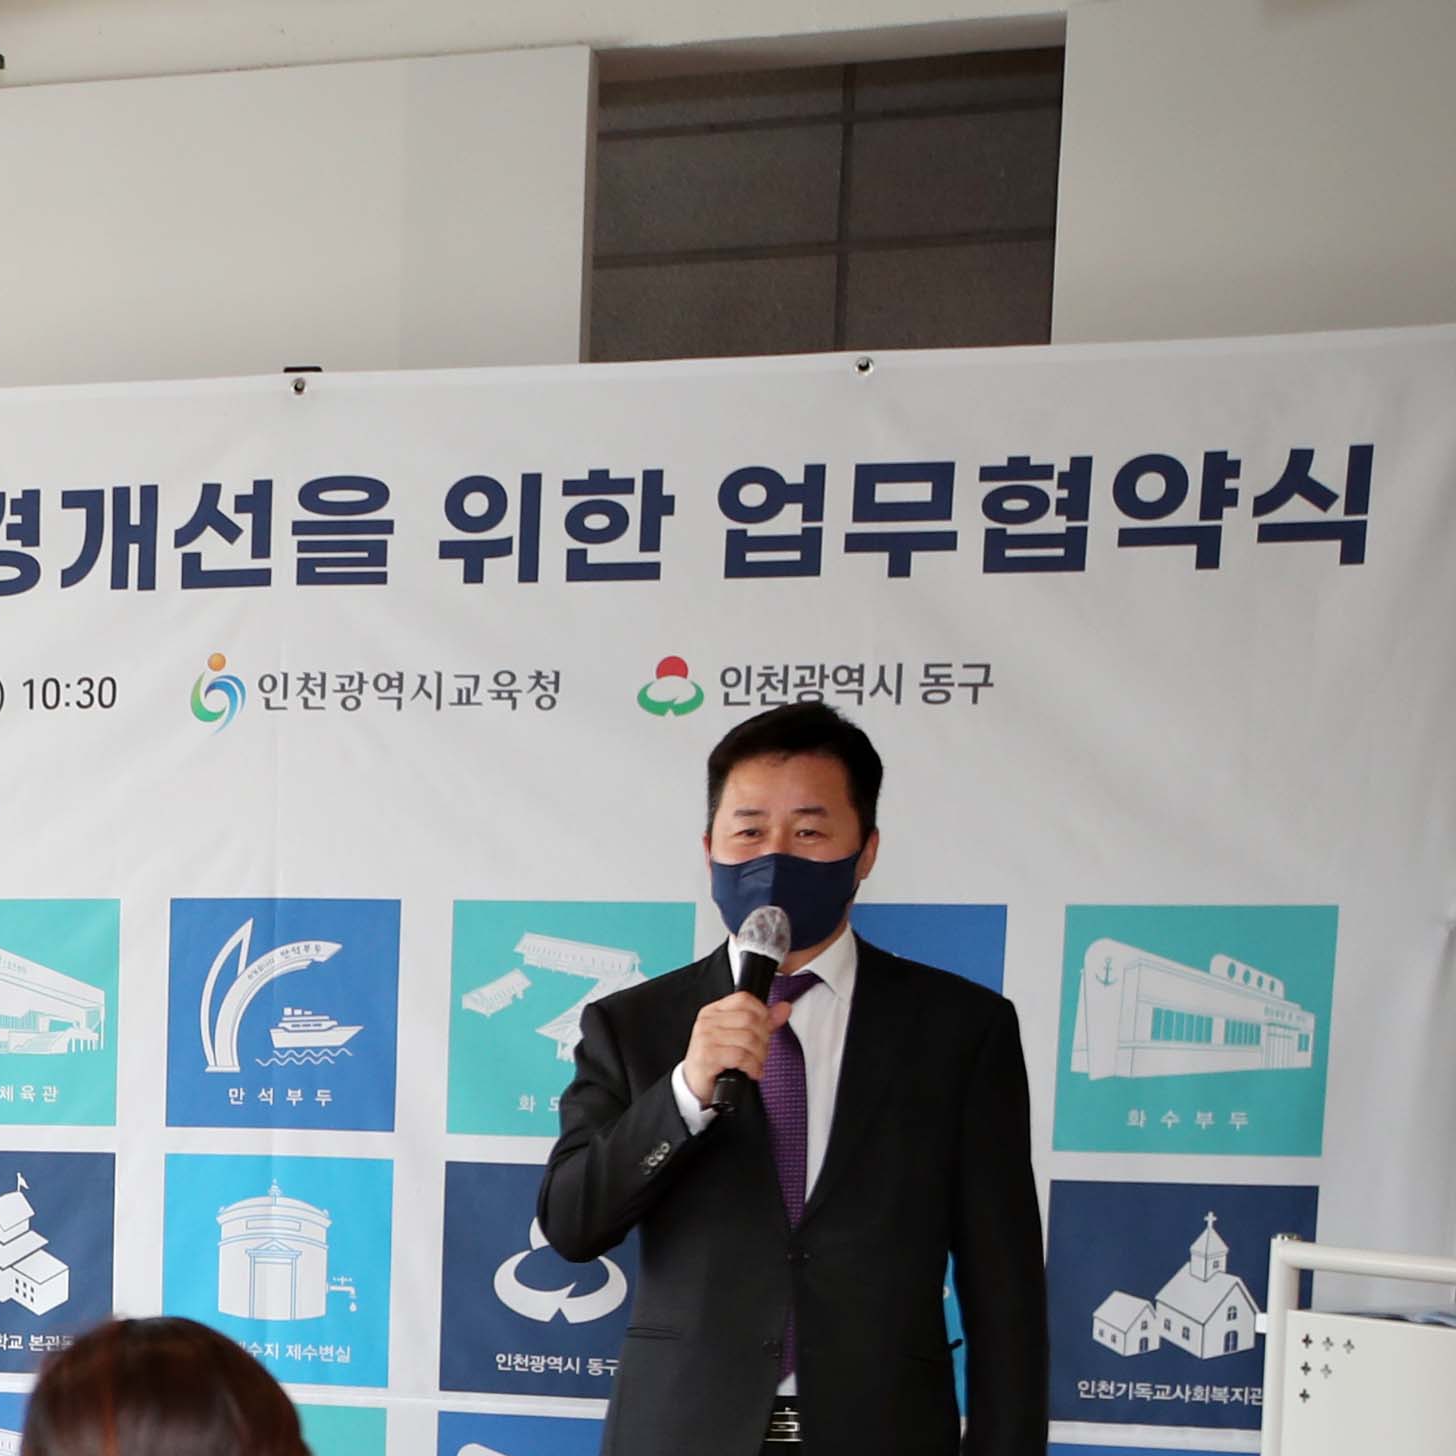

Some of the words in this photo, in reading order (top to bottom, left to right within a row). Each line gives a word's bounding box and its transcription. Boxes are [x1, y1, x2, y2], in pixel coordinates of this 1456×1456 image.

[438, 468, 676, 585] 위한
[717, 443, 1375, 580] 업무협약식
[22, 676, 117, 710] 10:30
[257, 669, 561, 712] 인천광역시교육청
[719, 662, 904, 705] 인천광역시
[919, 662, 995, 705] 동구
[228, 1087, 333, 1107] 만석부두
[1127, 1109, 1249, 1131] 화수부두
[285, 1343, 351, 1364] 제수변실
[495, 1353, 581, 1375] 인천광역시
[586, 1358, 620, 1377] 동구
